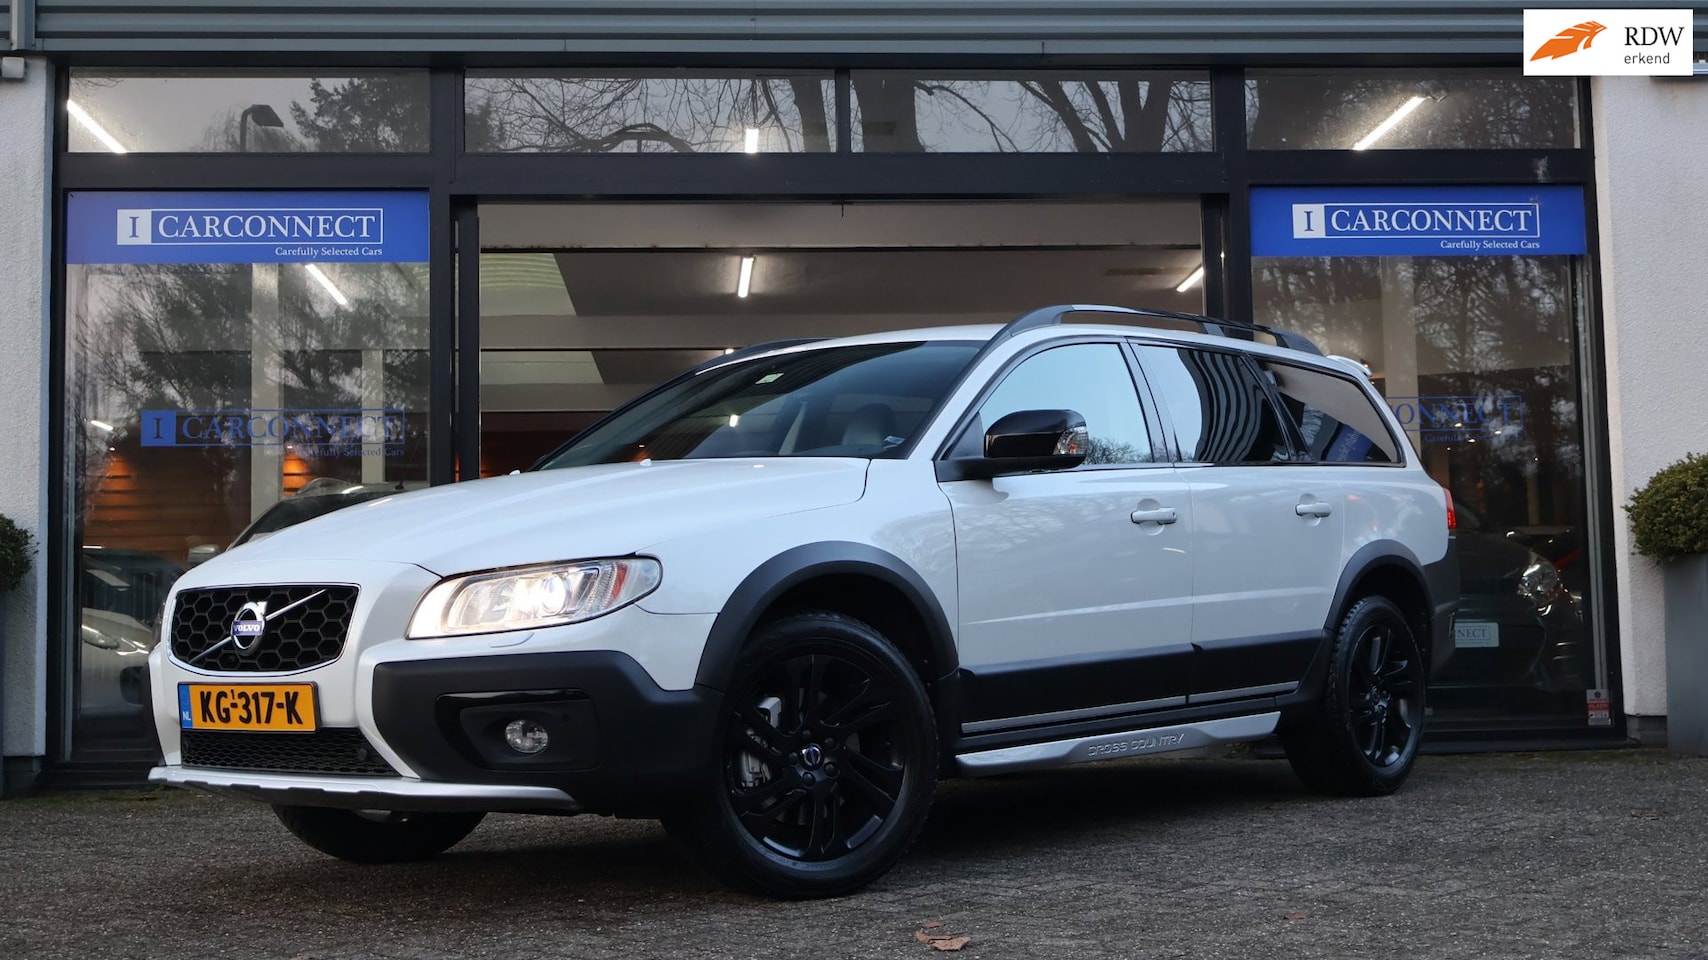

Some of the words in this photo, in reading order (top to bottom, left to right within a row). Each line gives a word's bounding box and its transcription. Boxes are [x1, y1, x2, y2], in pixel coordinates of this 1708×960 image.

[128, 216, 141, 239] I
[157, 215, 376, 239] CARCONNECT
[1303, 210, 1315, 232] I
[1330, 208, 1532, 232] CARCONNECT
[274, 246, 319, 258] Carefully
[321, 246, 359, 256] Selected
[361, 247, 383, 256] Cars
[1440, 240, 1481, 251] Carefully
[1482, 240, 1519, 250] Selected
[1520, 241, 1540, 249] Cars
[1392, 403, 1513, 425] ONNECT
[182, 415, 396, 440] CARCONNECT
[232, 623, 262, 634] VOLVO
[1457, 628, 1487, 639] NECT
[182, 711, 192, 722] NL
[199, 690, 304, 725] KG-317-K
[1088, 741, 1129, 757] CROSS
[1131, 733, 1185, 750] COUNTRY
